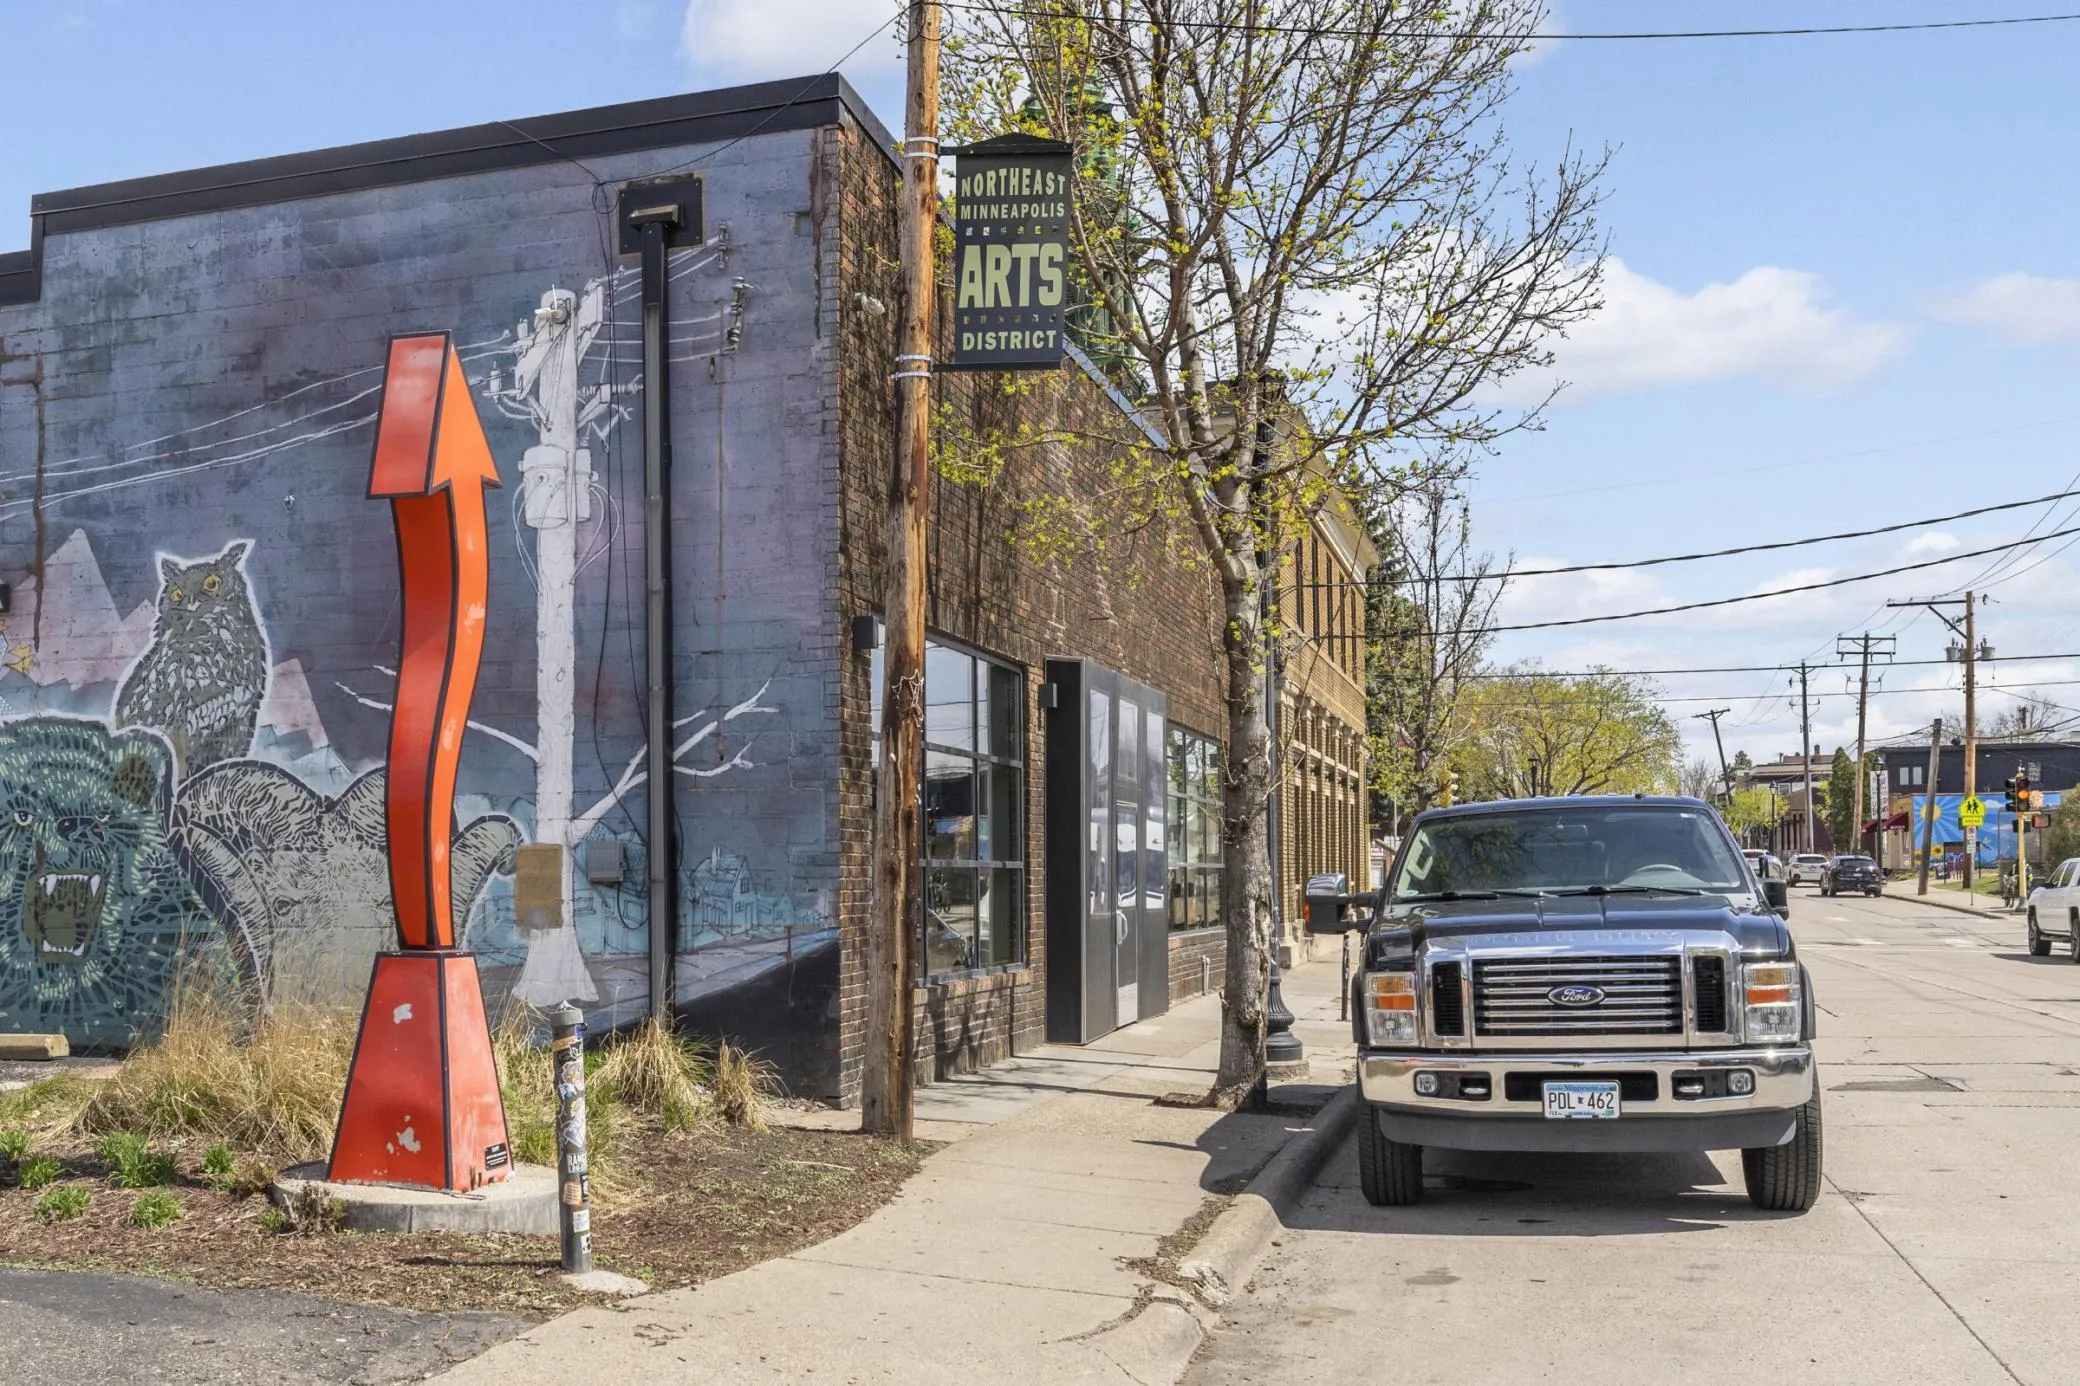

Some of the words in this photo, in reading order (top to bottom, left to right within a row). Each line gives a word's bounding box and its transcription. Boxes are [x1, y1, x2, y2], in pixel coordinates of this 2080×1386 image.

[962, 167, 1065, 197] NORTHEAST
[960, 202, 1065, 220] MINNEAPOLIS
[958, 243, 1064, 309] ARTS
[962, 330, 1057, 351] DISTRICT
[1561, 988, 1591, 1001] Ford
[1548, 1092, 1576, 1109] PDL
[1587, 1092, 1614, 1109] 462
